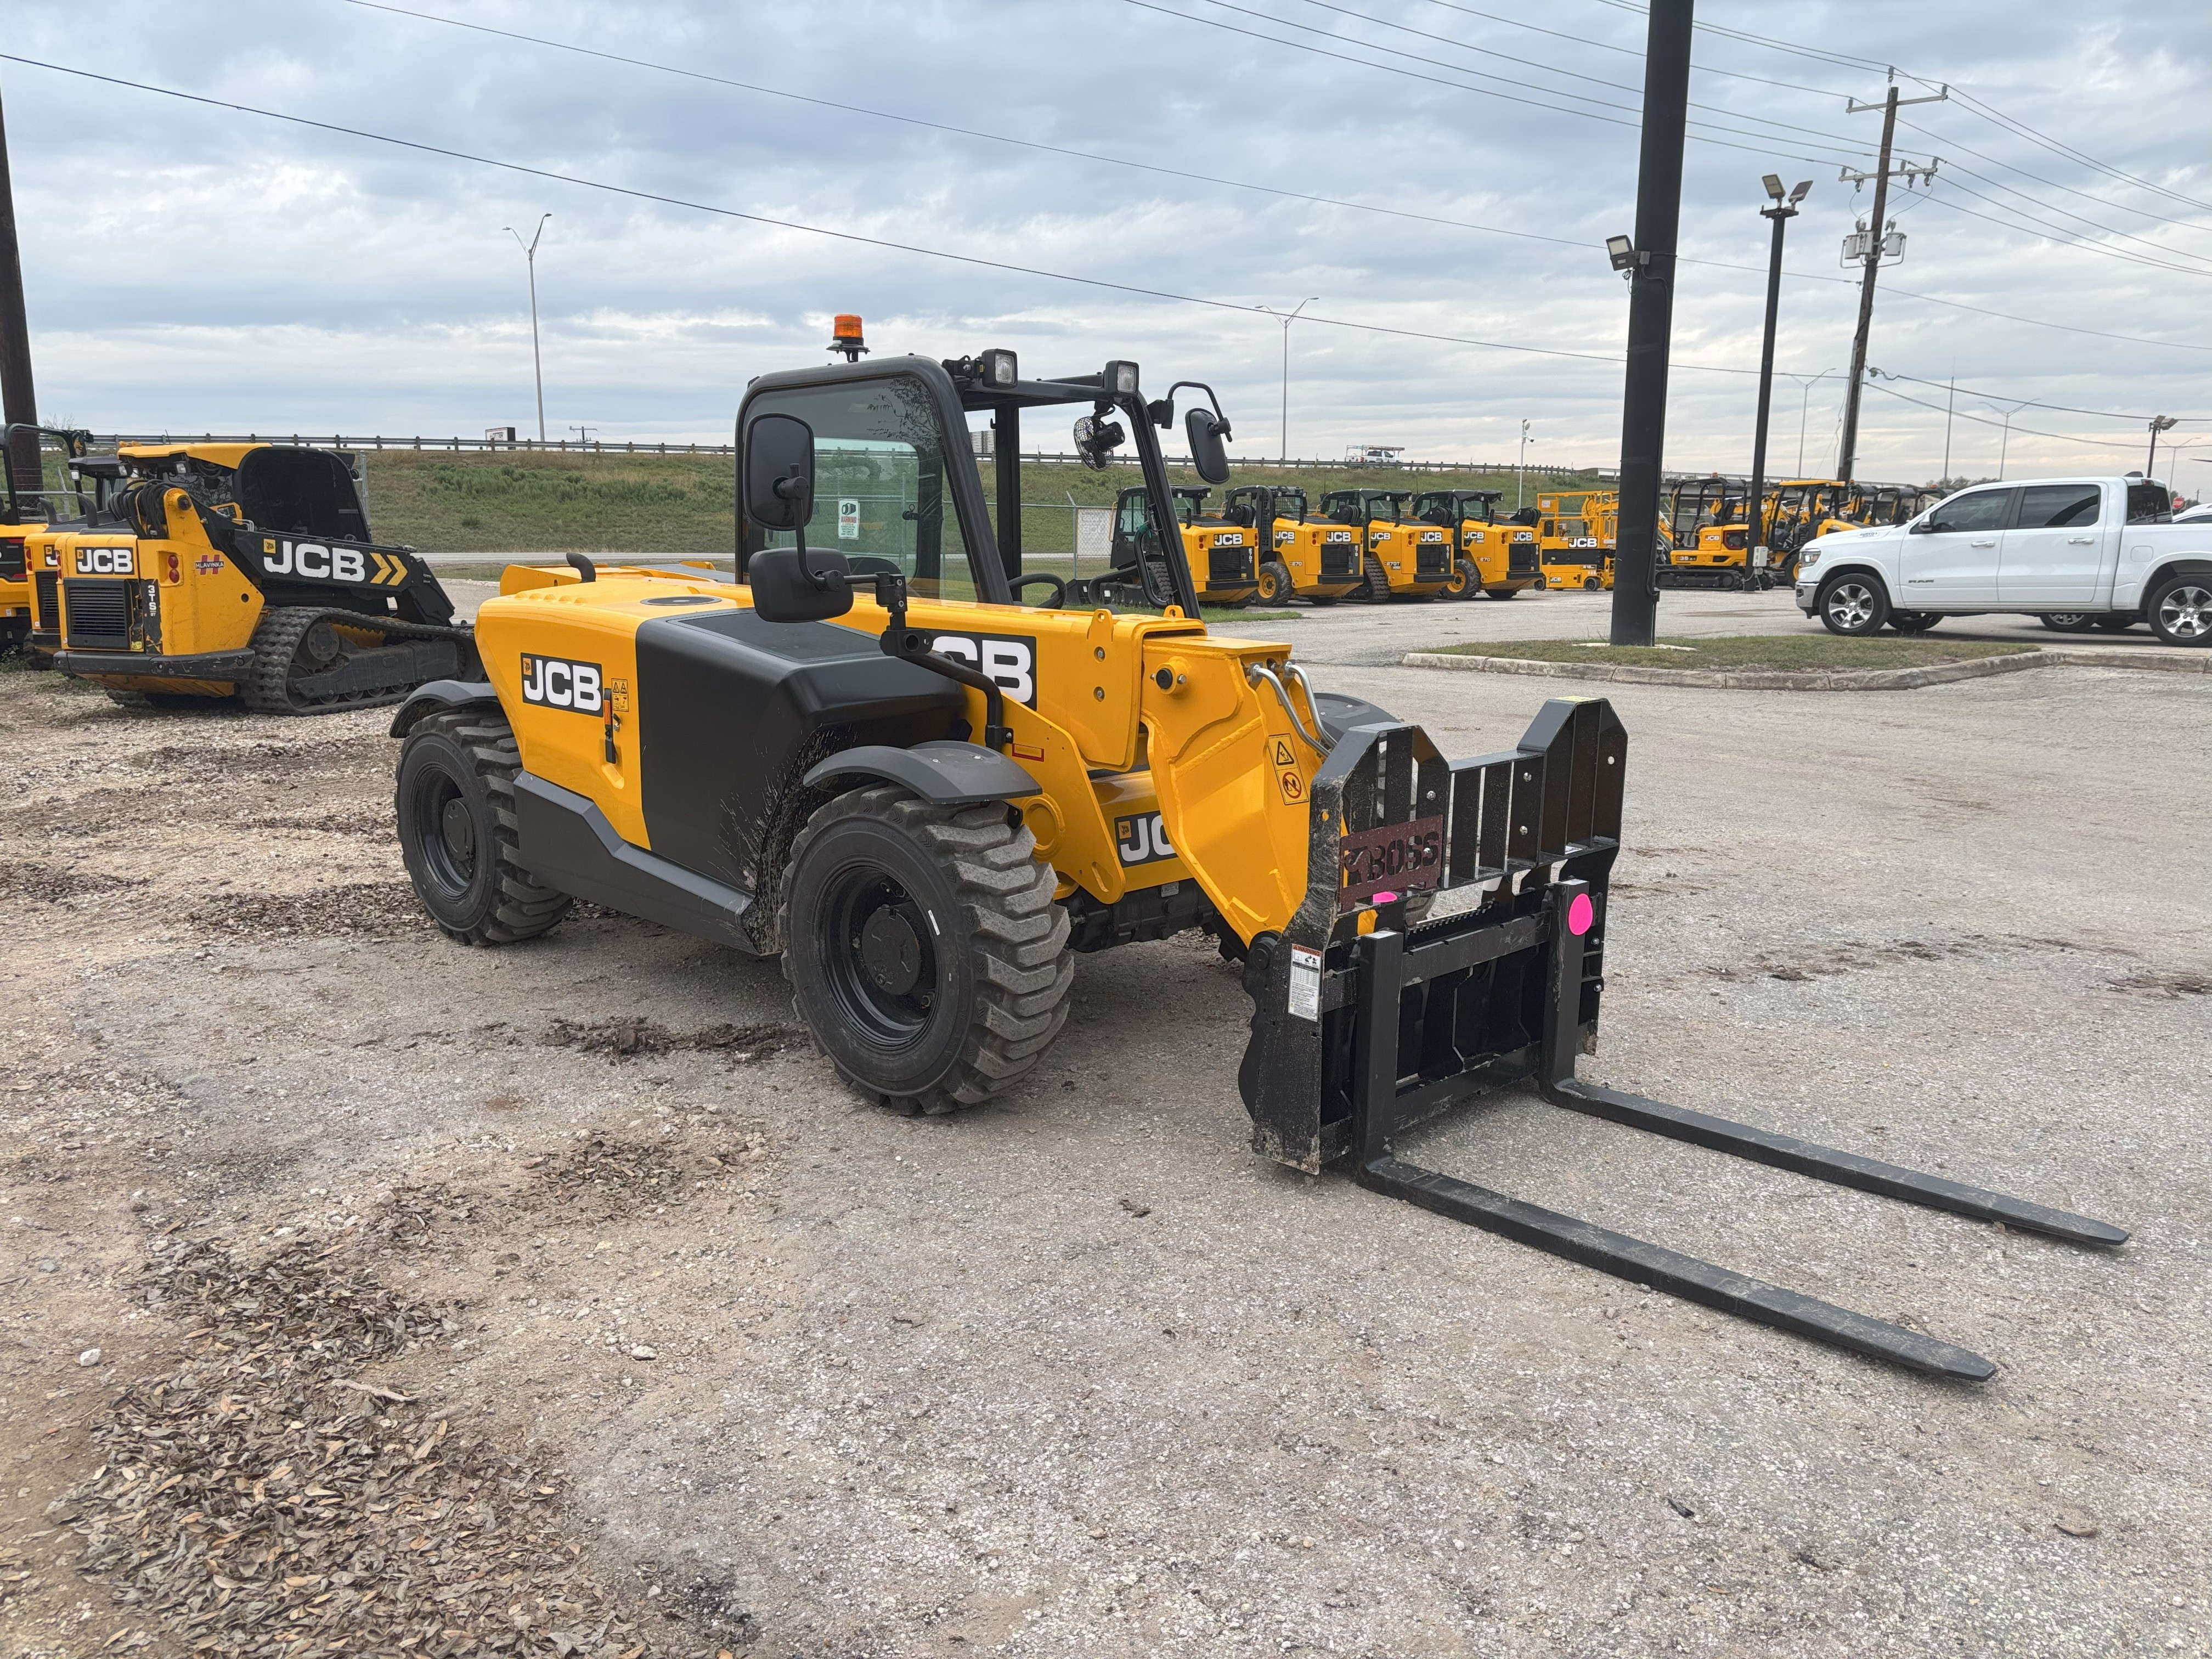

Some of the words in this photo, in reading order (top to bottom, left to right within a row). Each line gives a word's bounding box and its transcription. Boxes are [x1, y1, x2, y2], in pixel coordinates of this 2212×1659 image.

[1214, 534, 1243, 545] JCB
[1327, 532, 1351, 542] JCB
[1421, 532, 1442, 542] JCB
[1514, 532, 1533, 541] JCB
[1569, 538, 1597, 548] JCB
[77, 549, 133, 572] JCB
[263, 541, 365, 582] JCB
[148, 585, 156, 610] 3TS
[523, 659, 601, 712] JCB
[1120, 815, 1176, 862] JC
